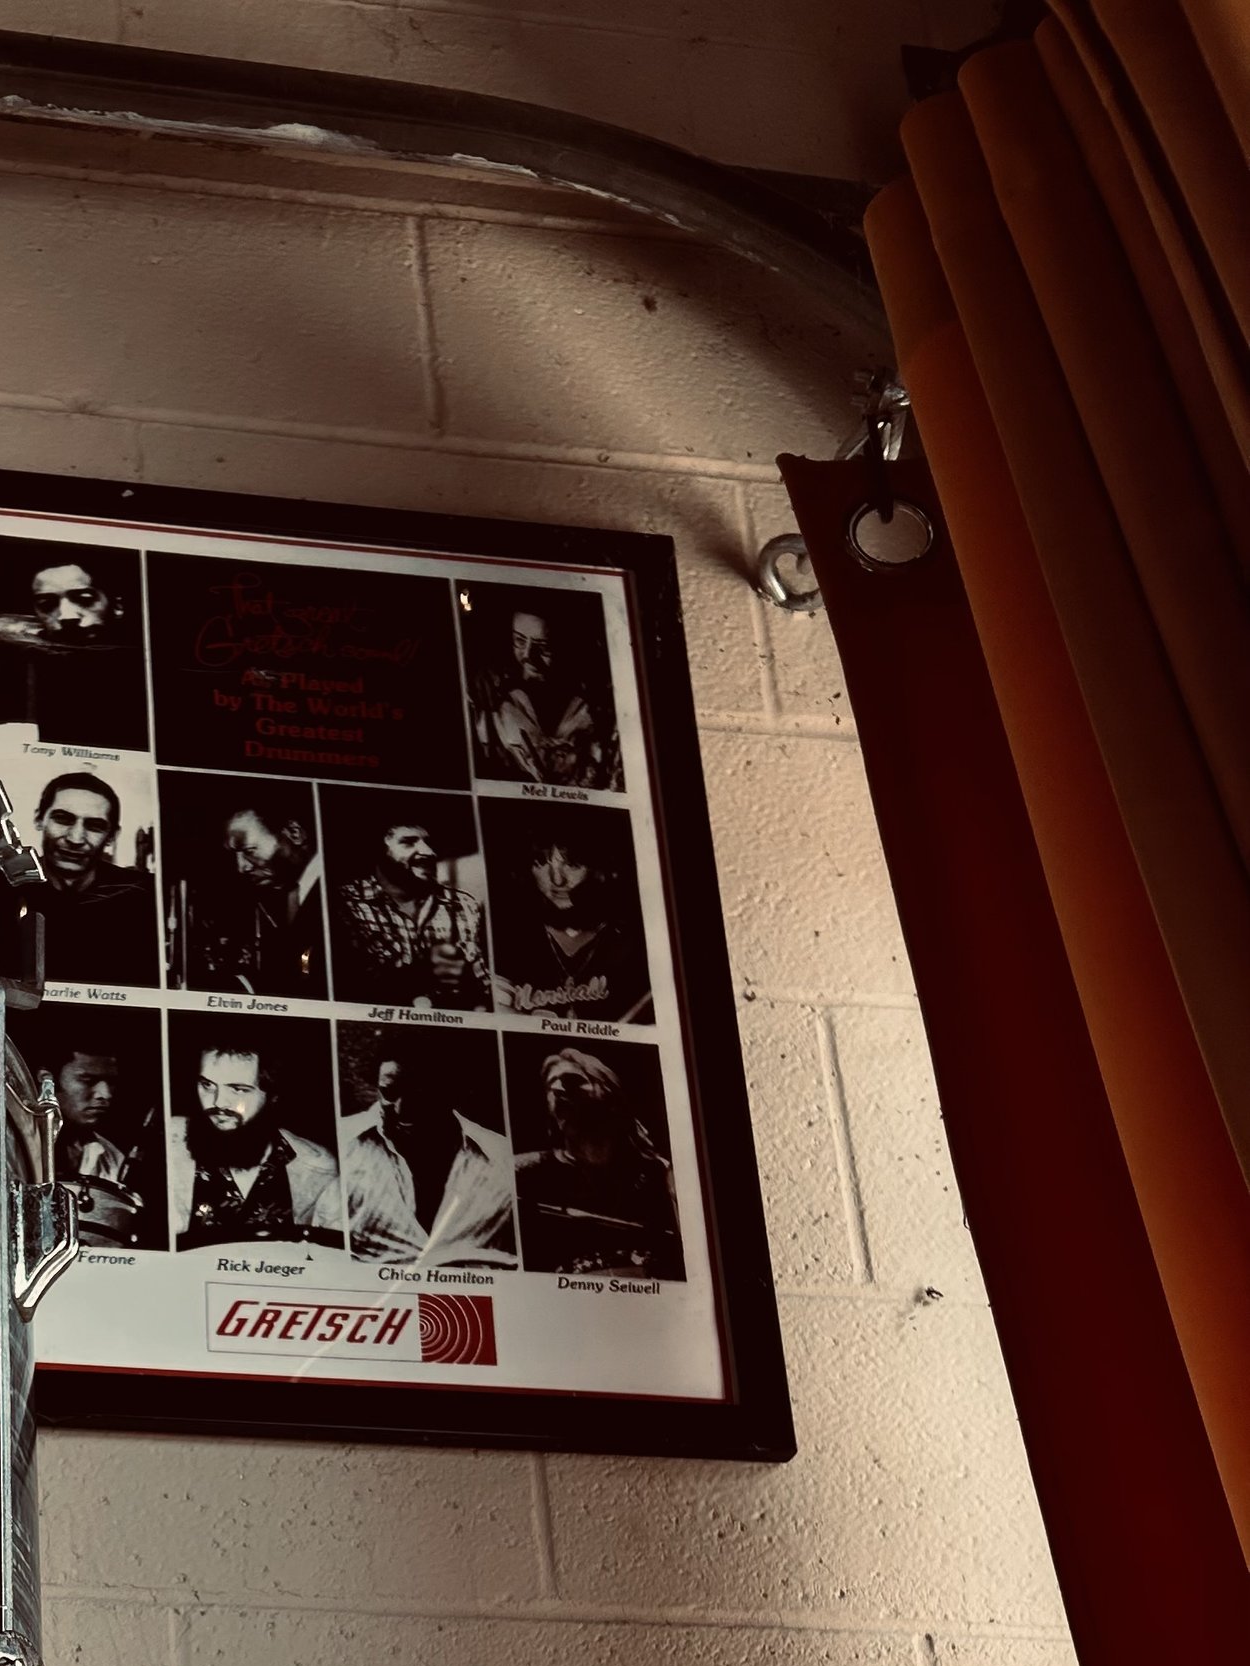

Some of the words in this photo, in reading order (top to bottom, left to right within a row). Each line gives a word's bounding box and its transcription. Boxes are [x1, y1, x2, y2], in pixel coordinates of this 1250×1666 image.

[279, 671, 365, 695] Played
[213, 688, 242, 711] by
[251, 692, 298, 714] The
[307, 697, 405, 721] World's
[255, 716, 365, 743] Greatest
[22, 743, 56, 758] Tony
[61, 746, 121, 762] Williams
[244, 740, 380, 768] Drummers
[521, 784, 548, 798] Mel
[551, 786, 590, 801] Lewis
[43, 987, 81, 999] arlie
[87, 988, 127, 1001] Watts
[207, 995, 243, 1011] Elvin
[247, 998, 289, 1013] Jones
[368, 1007, 395, 1022] Jeff
[398, 1009, 464, 1025] Hamilton
[541, 1018, 572, 1034] Paul
[576, 1021, 620, 1038] Riddle
[78, 1250, 136, 1266] Ferrone
[217, 1258, 251, 1273] Rick
[254, 1260, 306, 1277] Jaeger
[378, 1267, 422, 1282] Chico
[426, 1269, 495, 1286] Hamilton
[557, 1276, 604, 1294] Denny
[609, 1279, 661, 1296] Seiwell
[216, 1300, 412, 1346] GRETSCH
